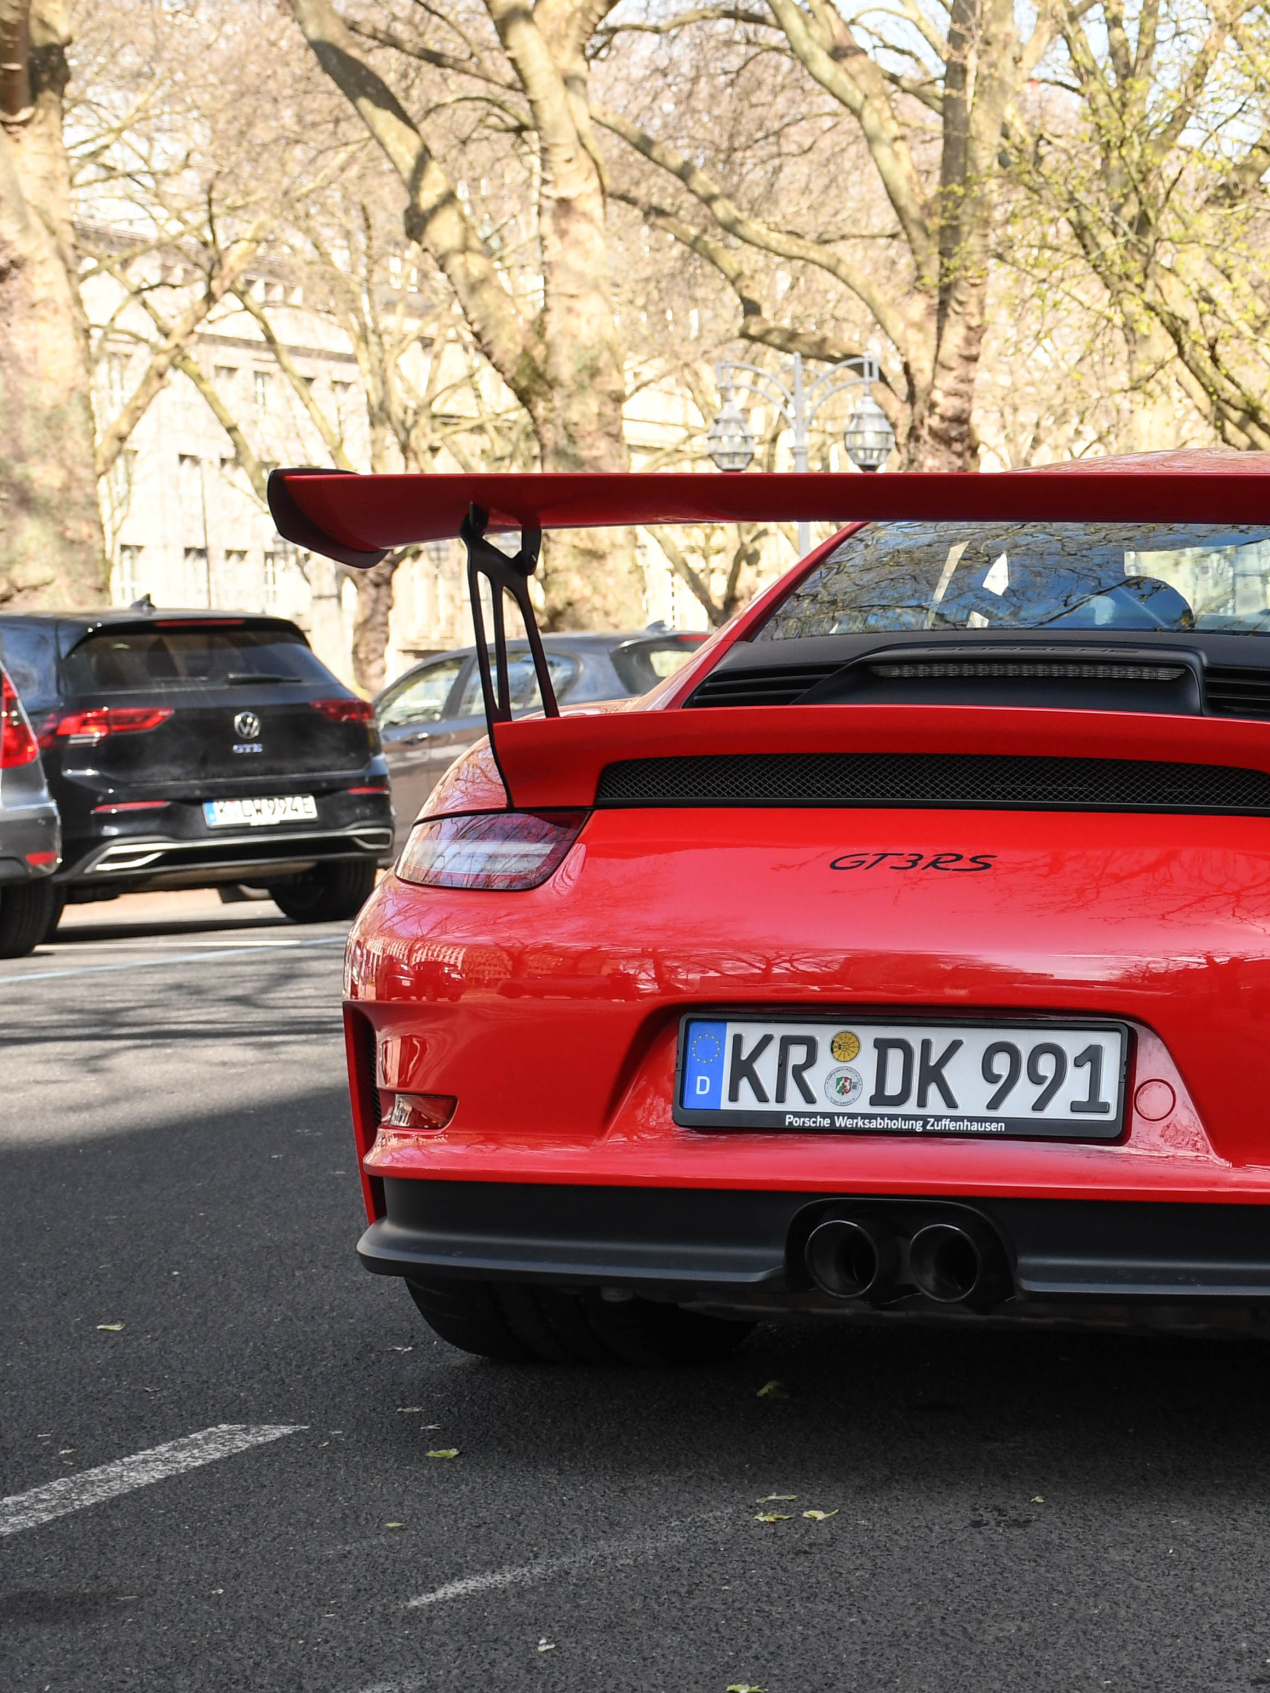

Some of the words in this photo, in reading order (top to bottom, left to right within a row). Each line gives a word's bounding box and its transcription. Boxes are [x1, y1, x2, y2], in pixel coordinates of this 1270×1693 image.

[727, 1033, 818, 1104] KR
[870, 1038, 964, 1109] DK
[981, 1041, 1110, 1114] 991
[696, 1077, 710, 1095] D
[785, 1114, 830, 1127] Porsche
[834, 1116, 923, 1131] Werksabholung
[926, 1118, 1005, 1132] Zuffenhausen
